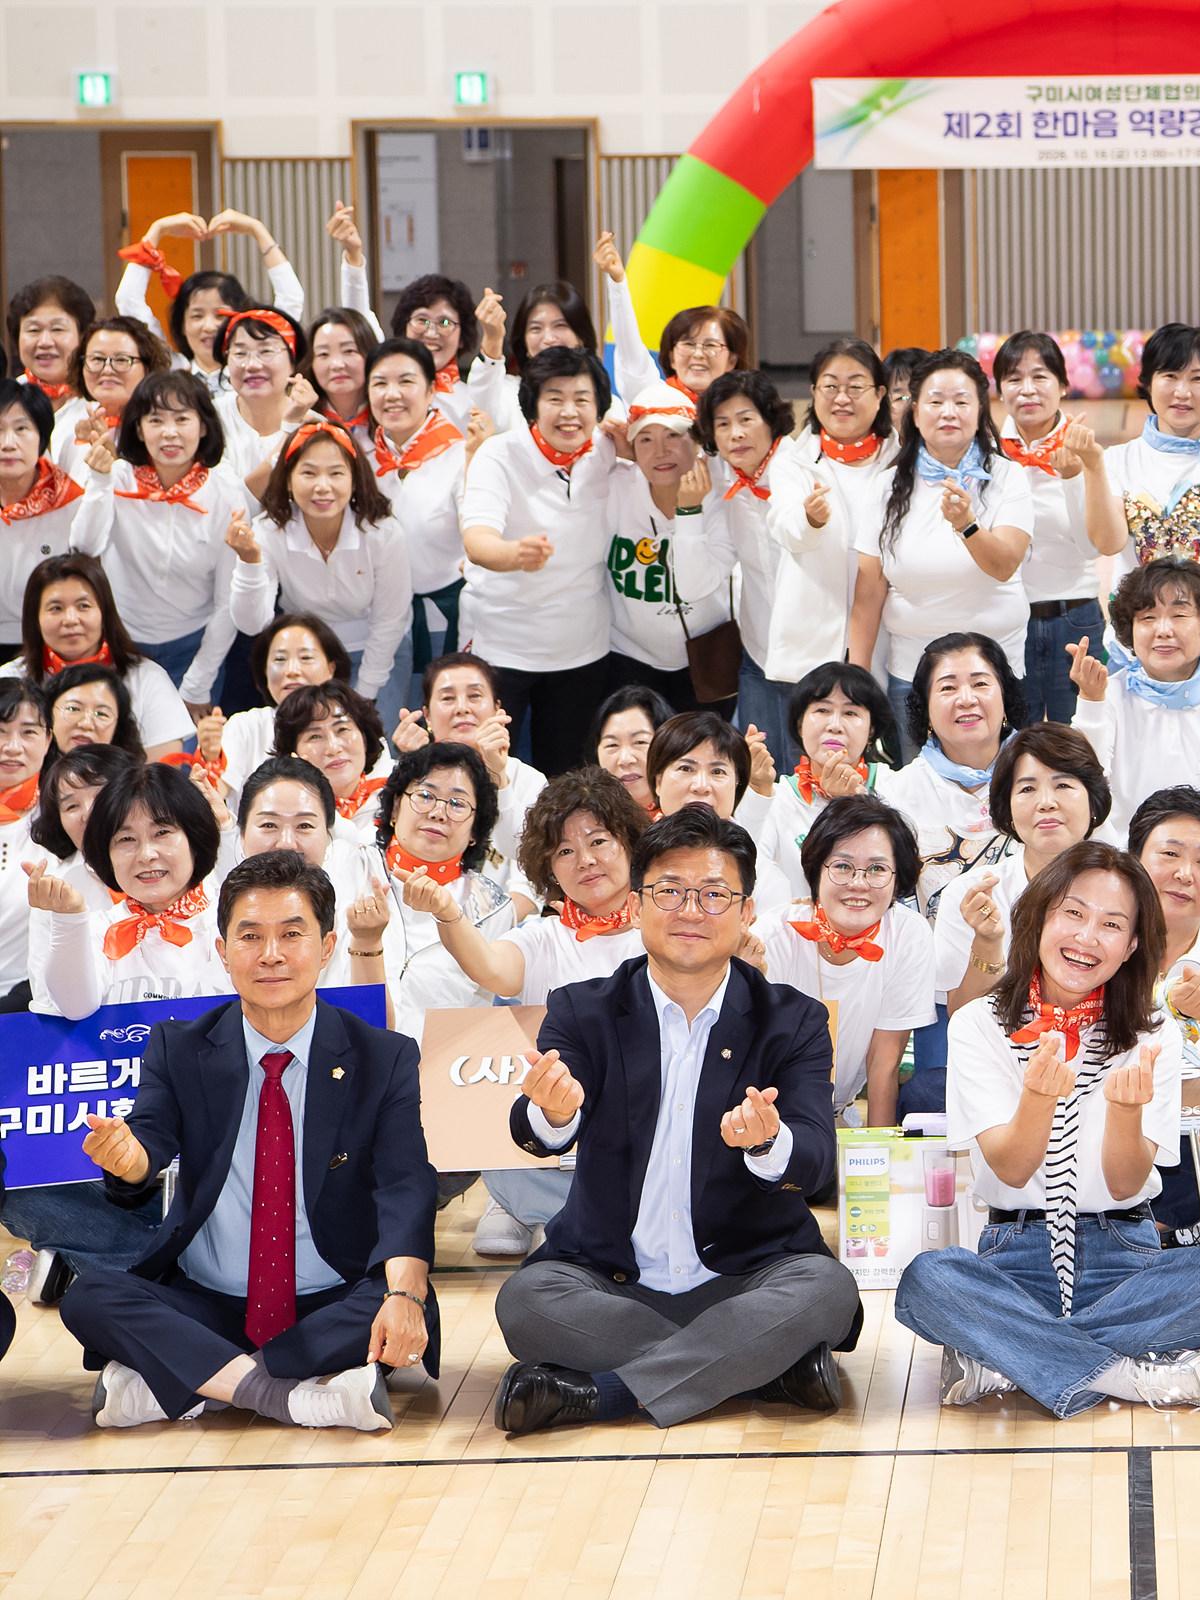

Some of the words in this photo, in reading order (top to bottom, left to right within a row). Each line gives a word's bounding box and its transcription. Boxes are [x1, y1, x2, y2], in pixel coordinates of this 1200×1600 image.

[943, 111, 1021, 138] 제2회
[1033, 109, 1118, 138] 한마음
[849, 1158, 886, 1166] PHILIPS
